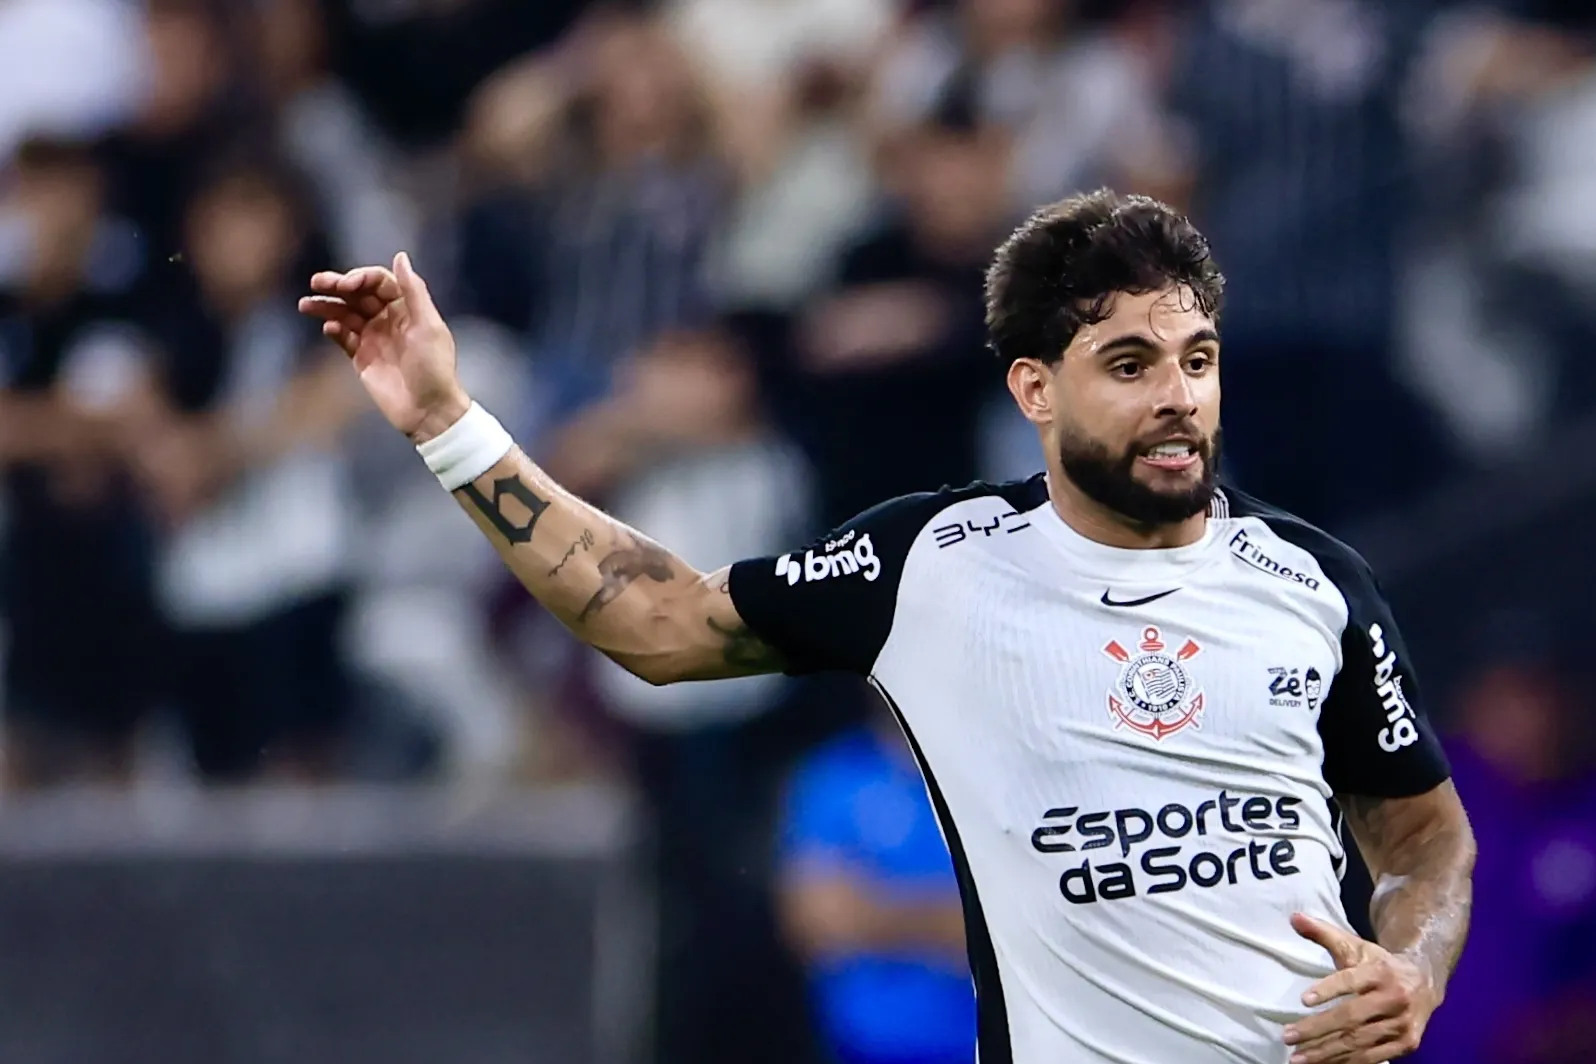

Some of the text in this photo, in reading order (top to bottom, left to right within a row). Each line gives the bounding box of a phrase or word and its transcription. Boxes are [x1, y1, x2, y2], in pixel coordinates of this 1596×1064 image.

[804, 533, 881, 582] bmg
[1229, 528, 1320, 592] Frimesa
[1374, 650, 1419, 753] bmg
[1031, 789, 1303, 858] Esportes
